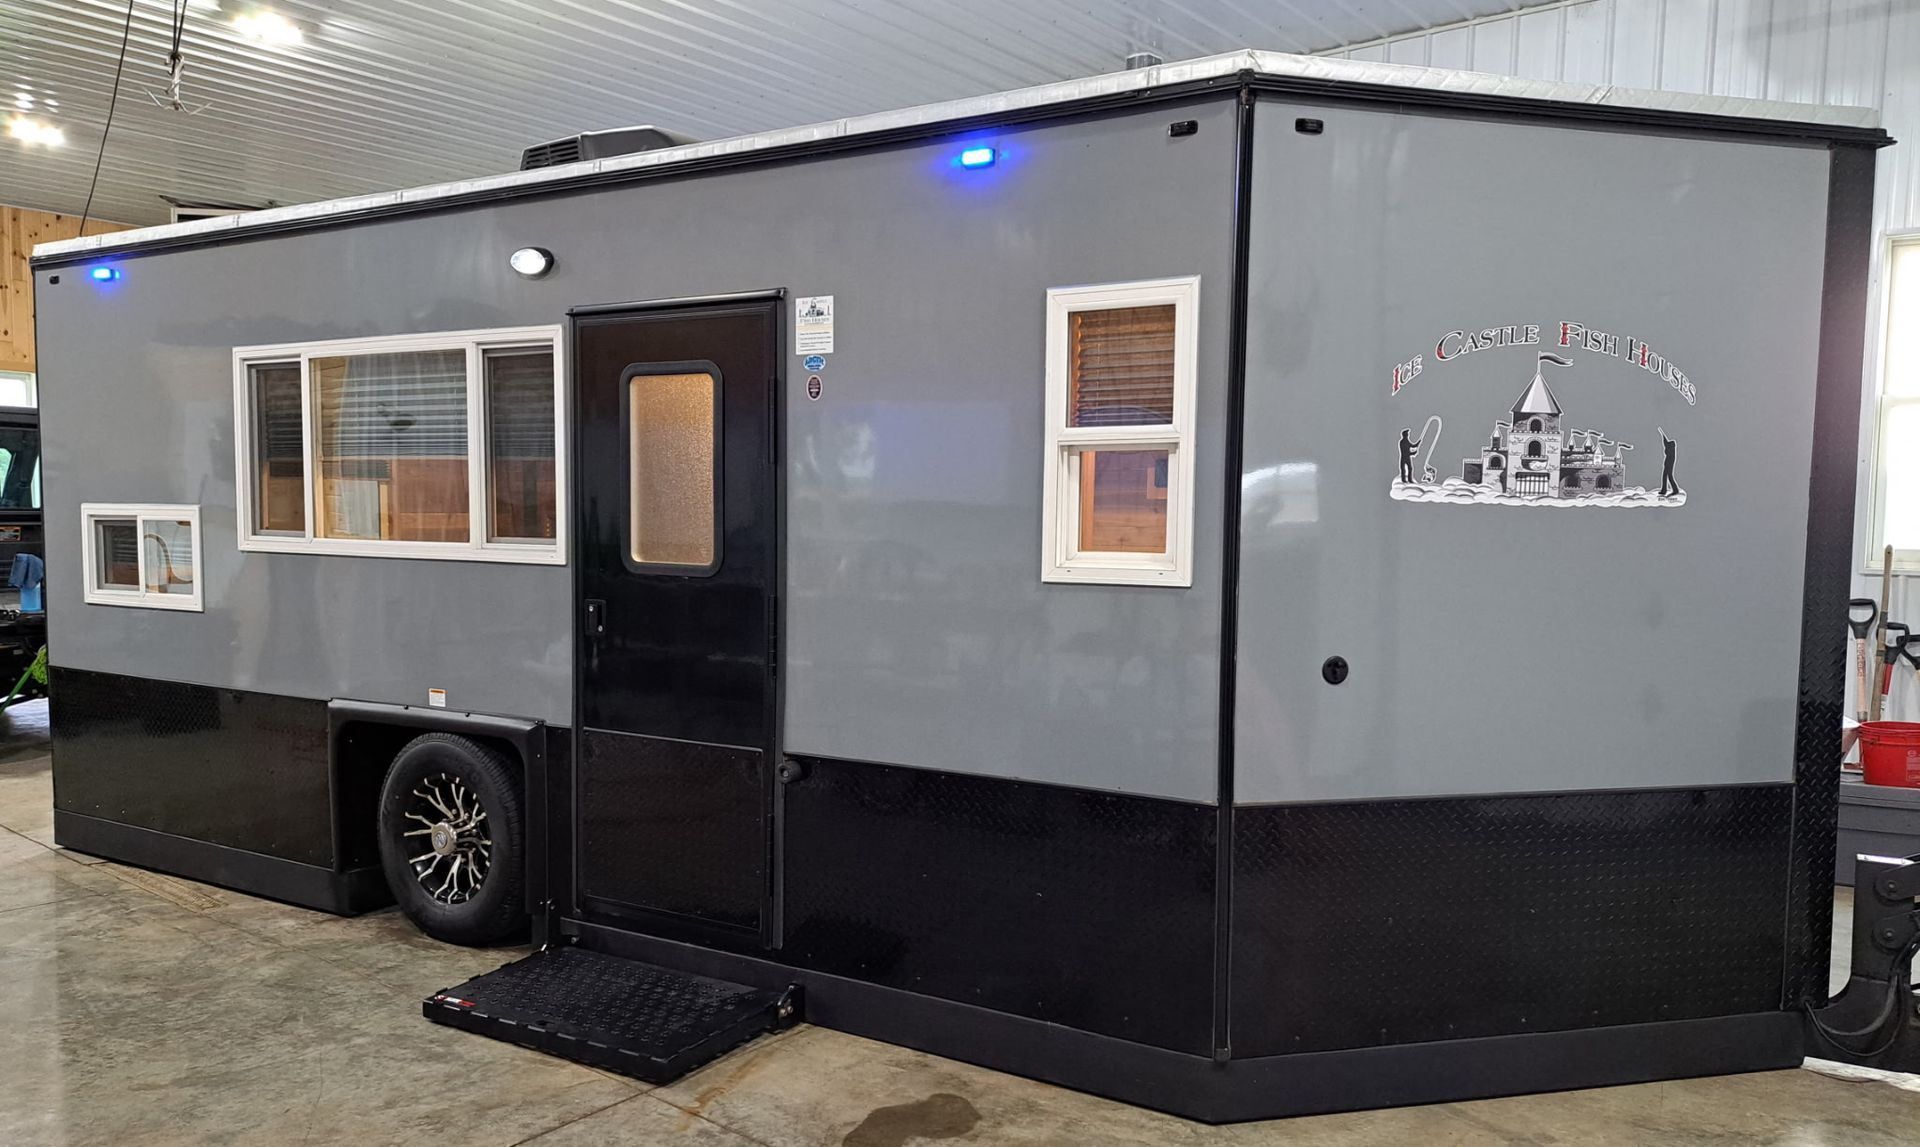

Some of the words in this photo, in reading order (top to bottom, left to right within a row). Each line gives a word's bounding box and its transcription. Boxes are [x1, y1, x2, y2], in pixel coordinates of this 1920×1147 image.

[1392, 354, 1422, 396] ICE
[1435, 325, 1540, 361] CASTLE
[1559, 321, 1619, 357] FISH
[1626, 336, 1696, 405] HOUSES
